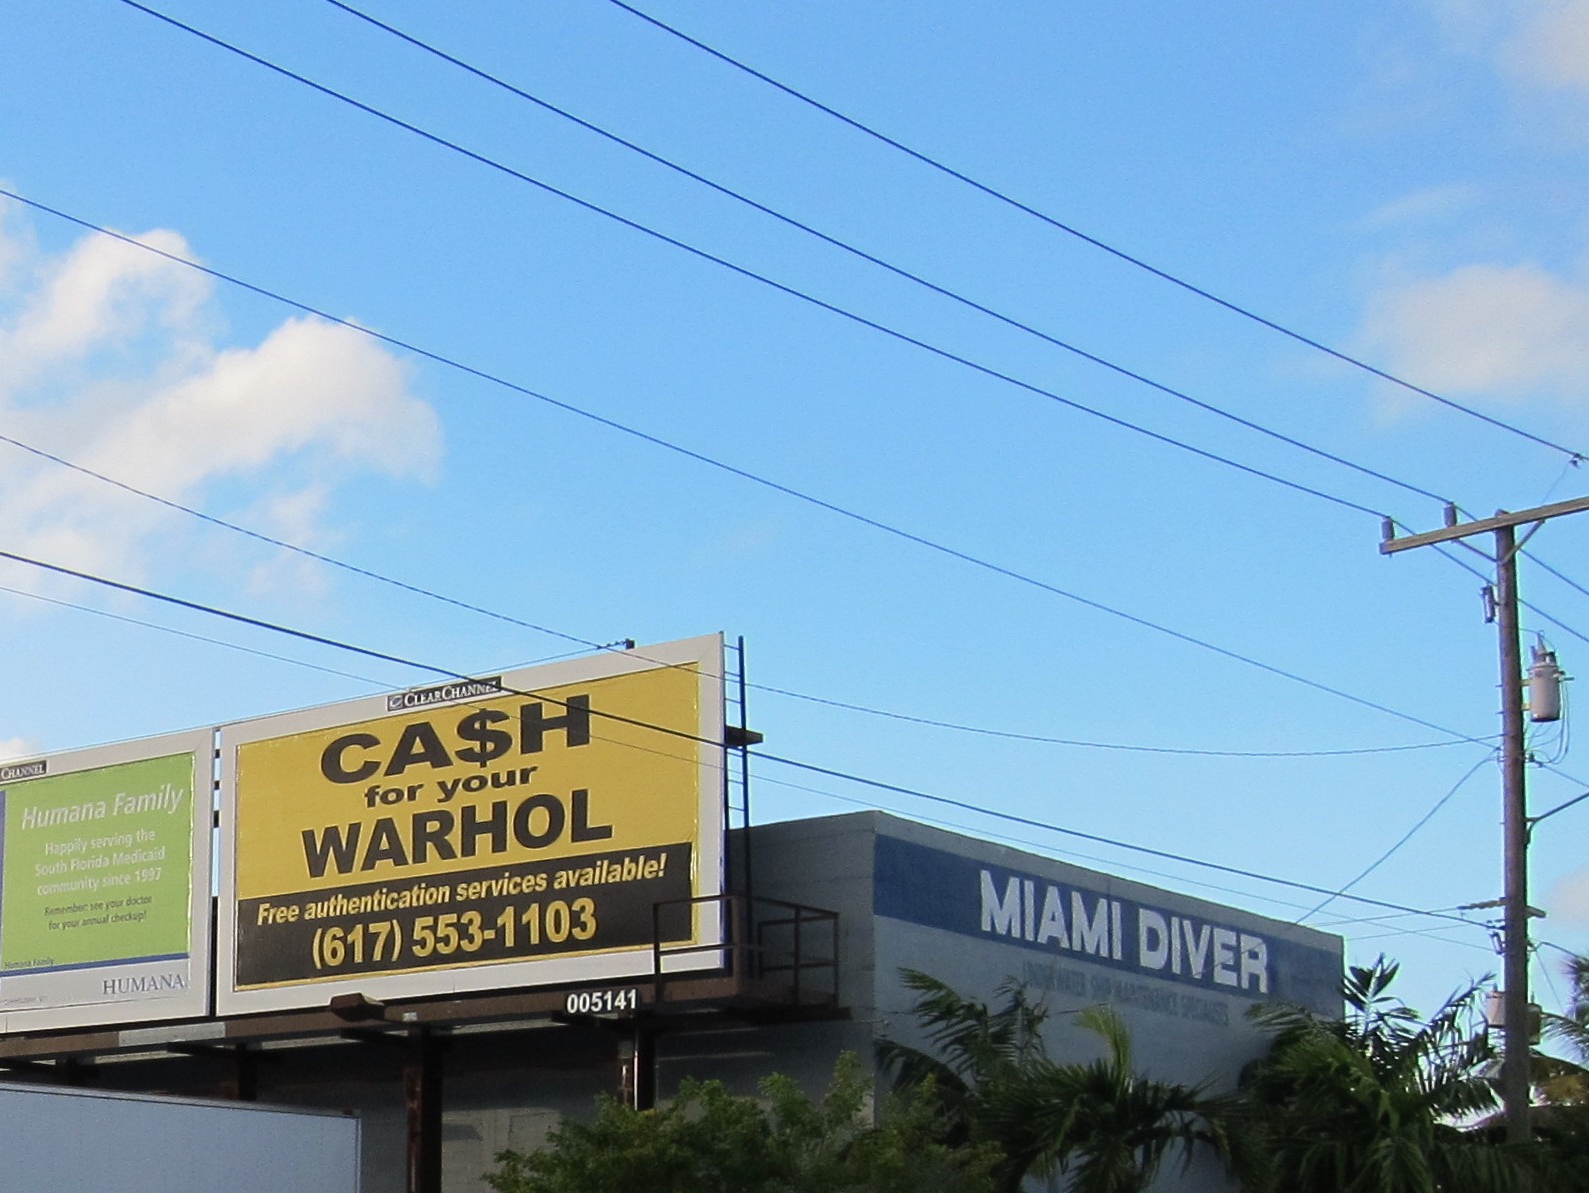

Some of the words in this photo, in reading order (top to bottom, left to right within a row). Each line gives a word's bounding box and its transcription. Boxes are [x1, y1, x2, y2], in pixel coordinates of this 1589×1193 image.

[320, 694, 590, 784] CA$H
[21, 800, 107, 830] Humana
[112, 783, 184, 816] Family
[364, 783, 424, 808] for
[436, 766, 539, 803] your
[45, 837, 87, 857] Happily
[90, 832, 133, 850] serving
[136, 828, 156, 843] the
[301, 788, 613, 878] WARHOL
[35, 860, 67, 877] South
[70, 854, 110, 872] Florida
[112, 846, 166, 867] Medicaid
[37, 876, 101, 897] community
[102, 871, 131, 888] since
[135, 867, 163, 883] 1997
[90, 901, 104, 912] see
[105, 898, 124, 912] your
[256, 902, 301, 926] Free
[304, 882, 451, 920] authentication
[455, 875, 548, 902] services
[553, 852, 668, 890] available!
[48, 920, 61, 932] for
[61, 917, 81, 931] your
[312, 919, 403, 970] (617)
[411, 896, 598, 958] 553-1103
[979, 868, 1124, 962] MIAMI
[1137, 907, 1269, 995] DIVER
[565, 988, 639, 1014] 005141
